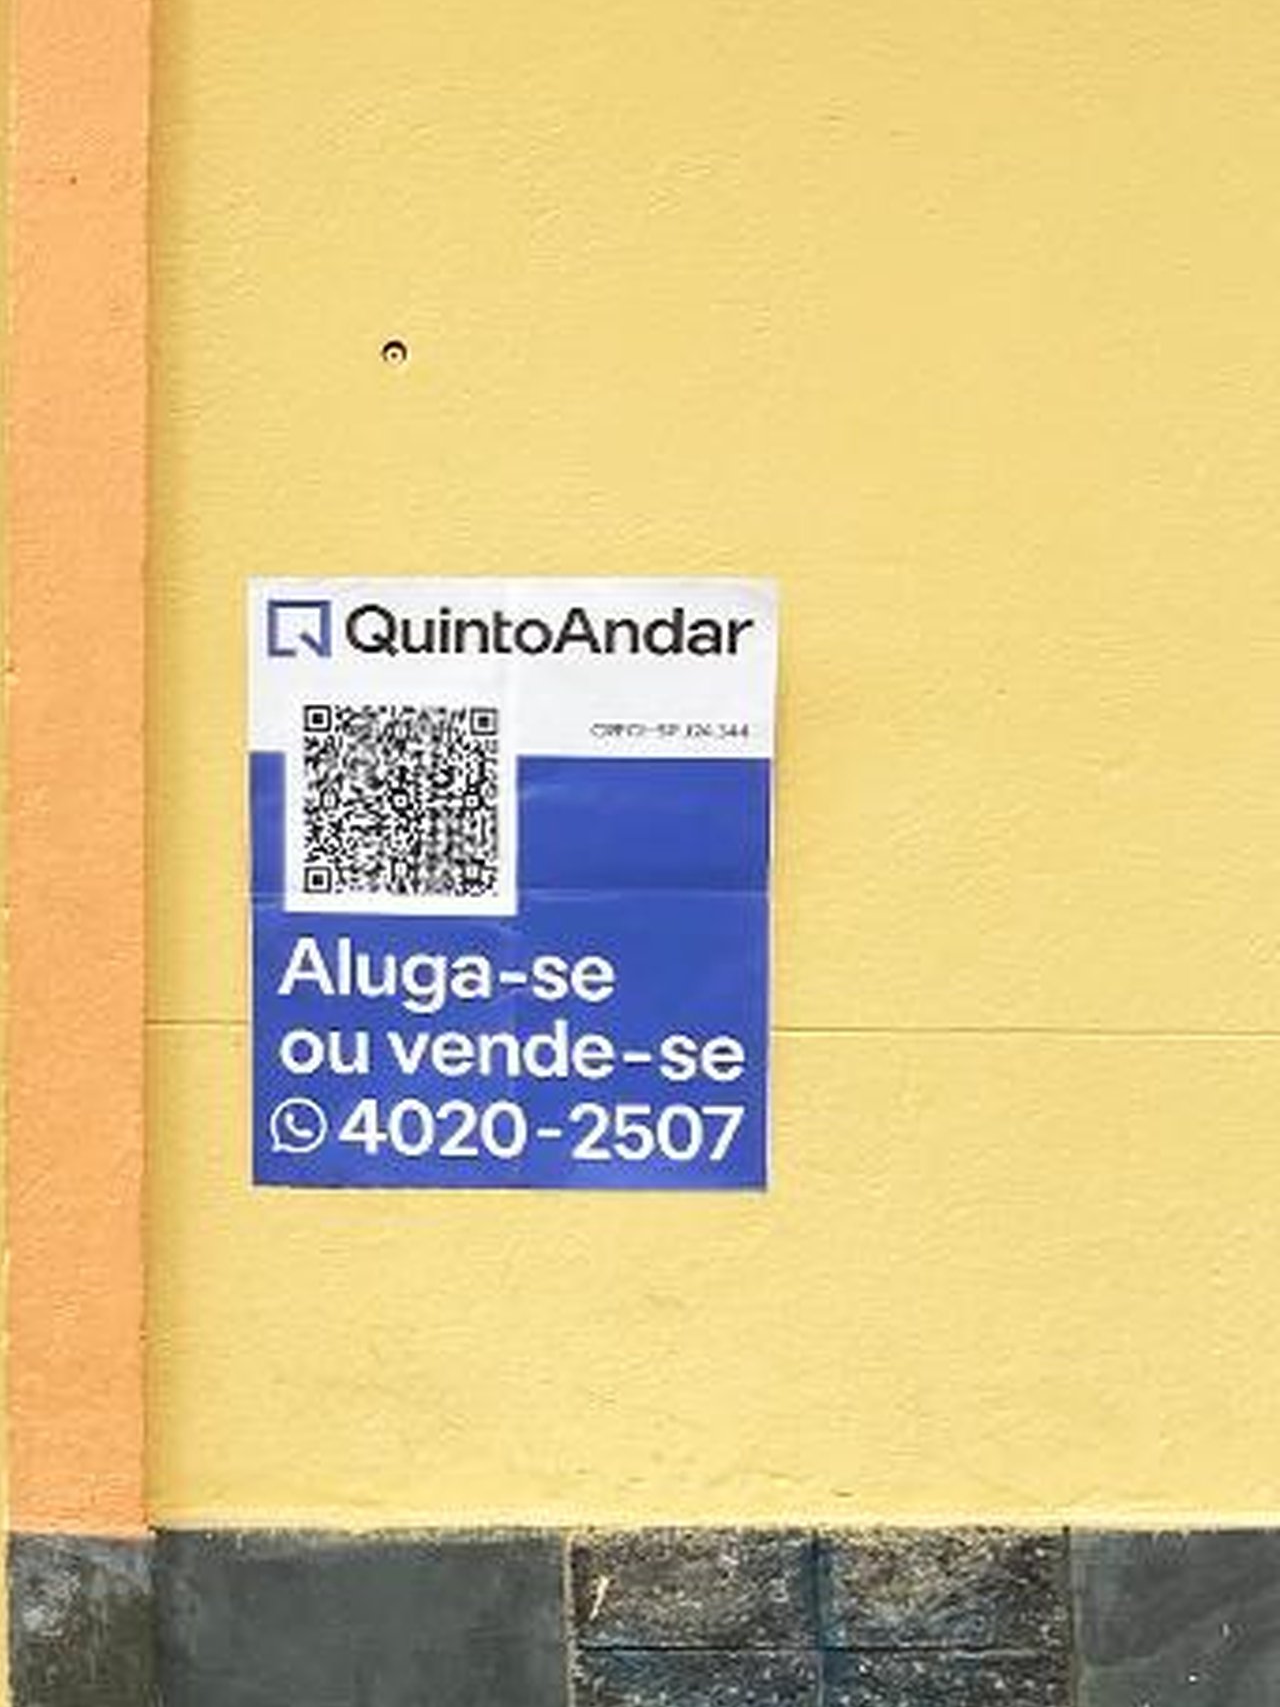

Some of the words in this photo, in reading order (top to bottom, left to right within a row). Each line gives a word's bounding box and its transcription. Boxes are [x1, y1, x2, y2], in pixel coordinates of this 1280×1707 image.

[344, 603, 753, 656] QuintoAndar
[277, 936, 616, 1013] Aluga-se
[279, 1029, 369, 1075] ou
[387, 1020, 746, 1081] vende-se
[338, 1097, 746, 1162] 4020-2507
